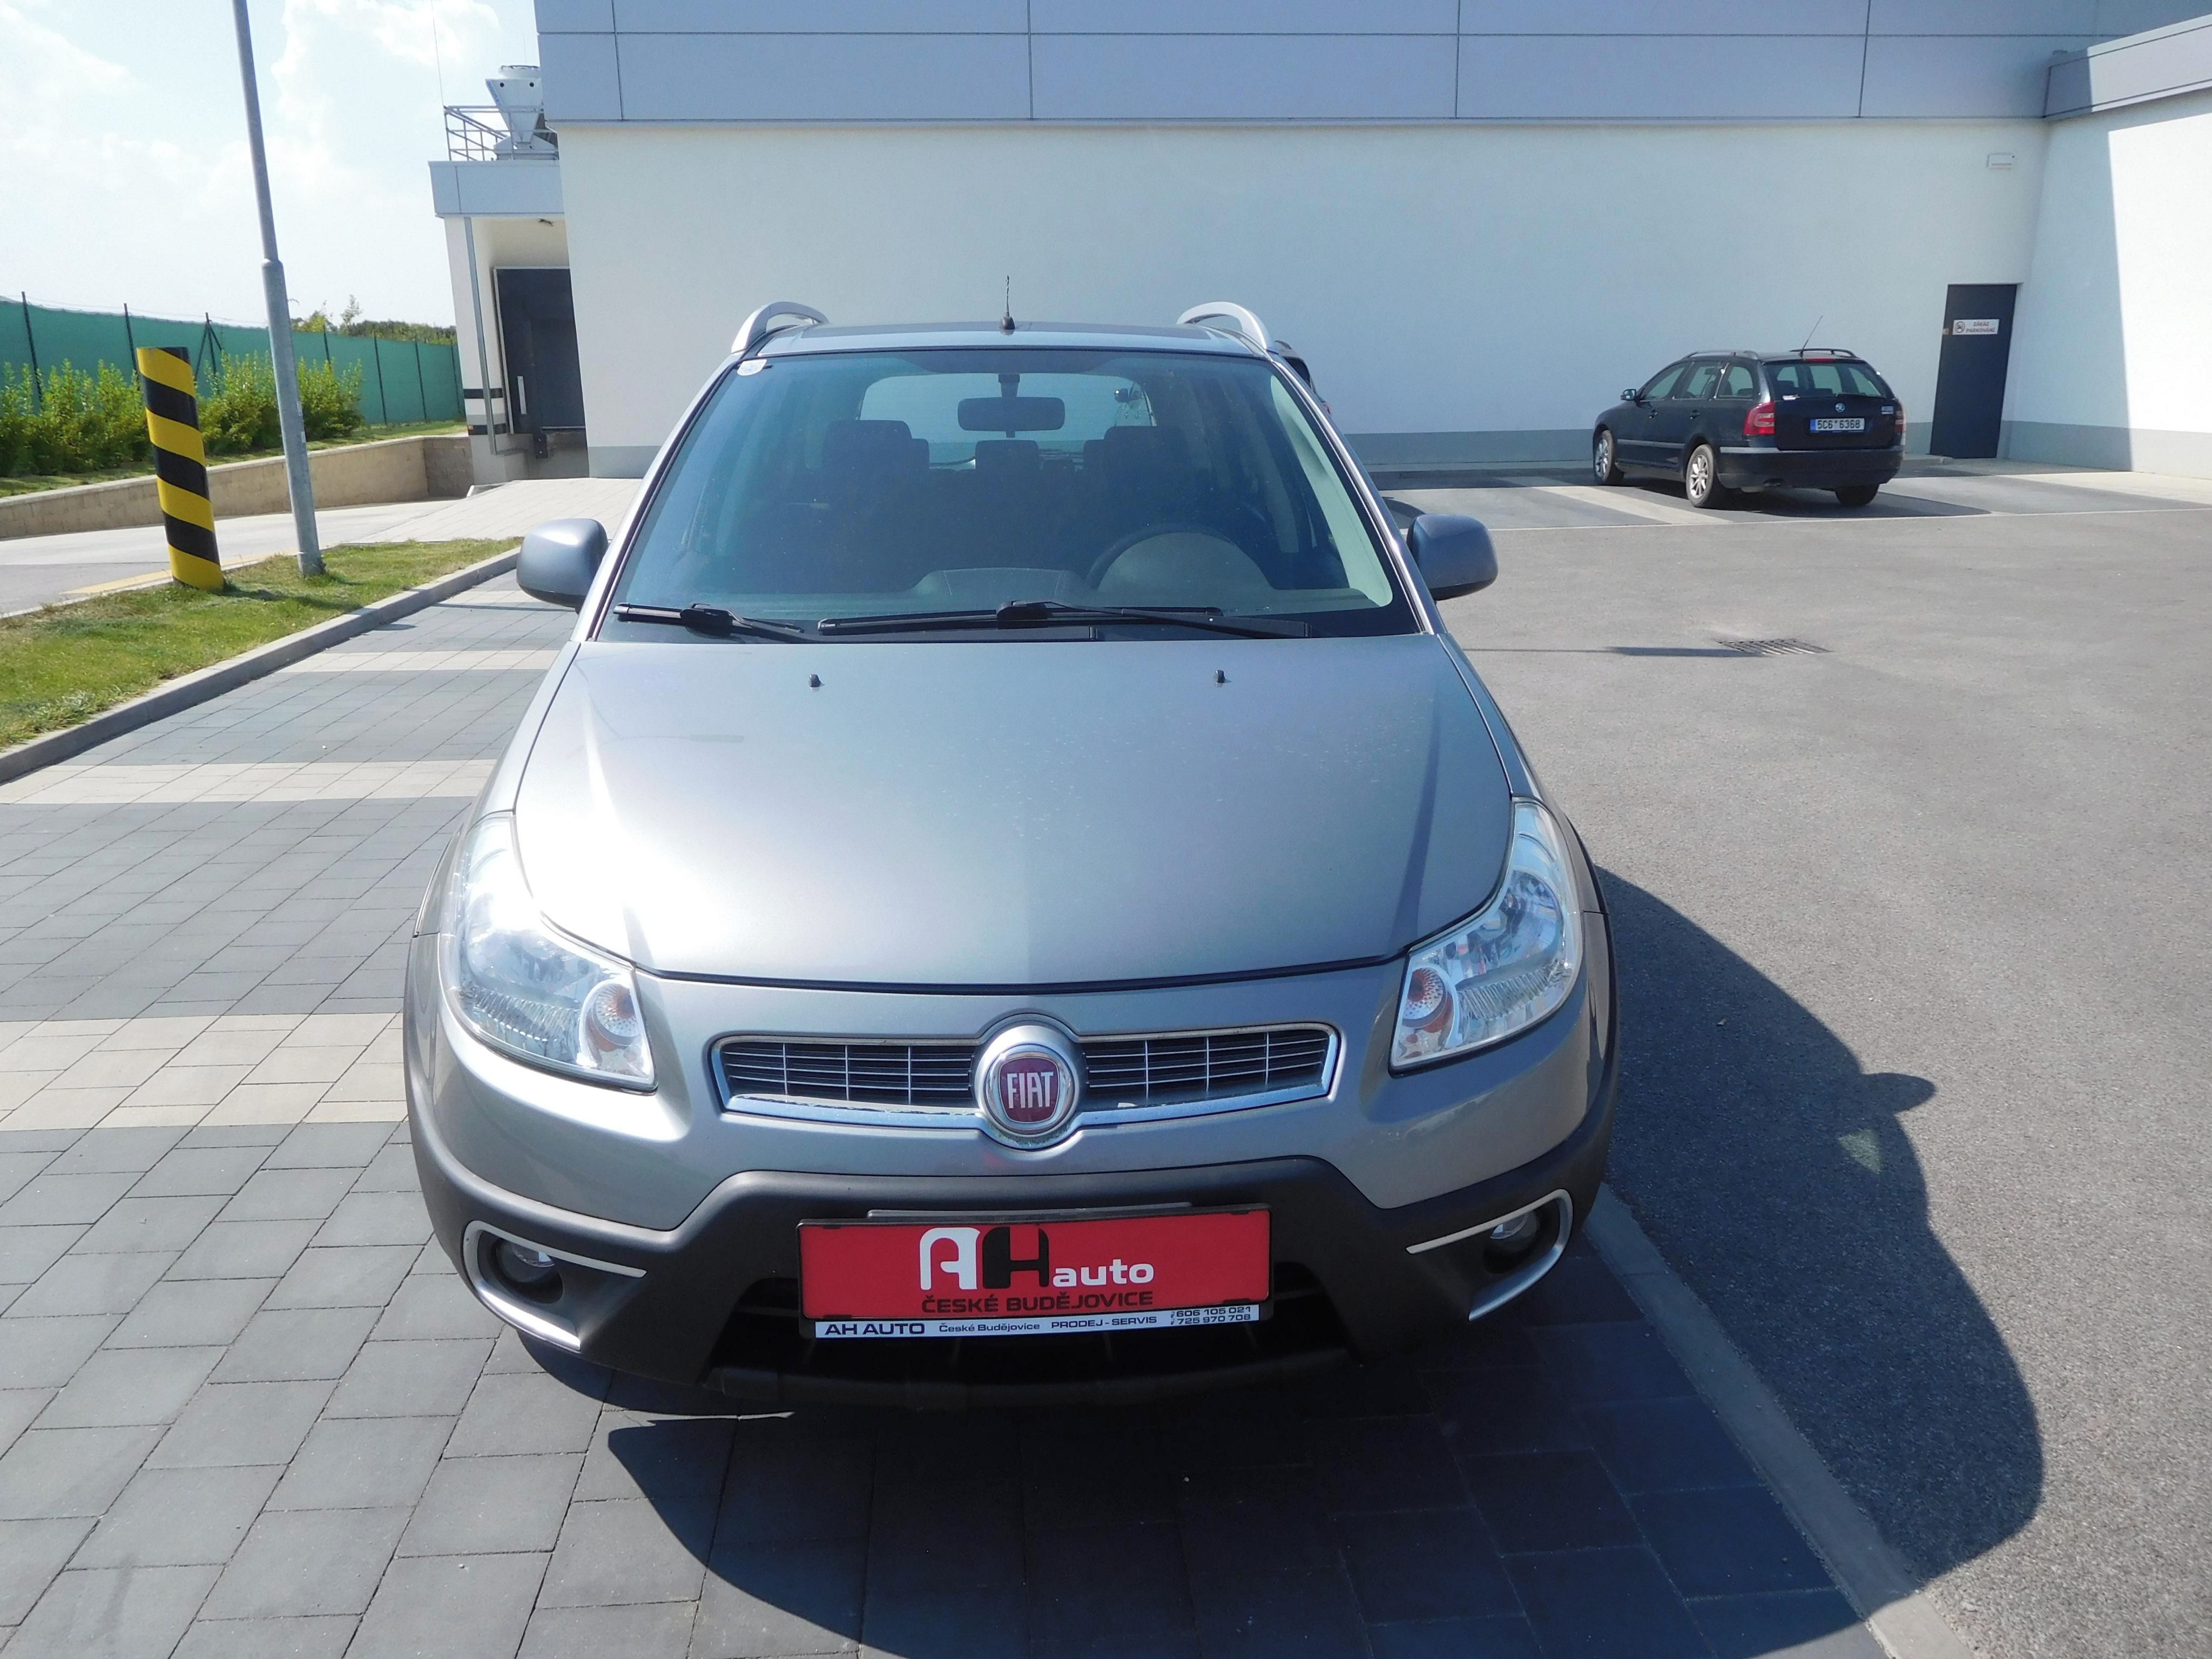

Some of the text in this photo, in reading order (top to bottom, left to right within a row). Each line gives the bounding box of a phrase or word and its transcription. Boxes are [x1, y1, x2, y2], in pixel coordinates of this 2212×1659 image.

[1817, 420, 1860, 429] 5C6 6368
[1007, 1071, 1054, 1109] FIAT
[920, 1226, 1154, 1290] AH auto
[921, 1291, 1154, 1313] ČESKÉ BUDĚJOVICE
[825, 1324, 858, 1335] AH
[862, 1323, 925, 1335] AUTO
[939, 1323, 975, 1332] České
[977, 1323, 1041, 1332] Budějovice
